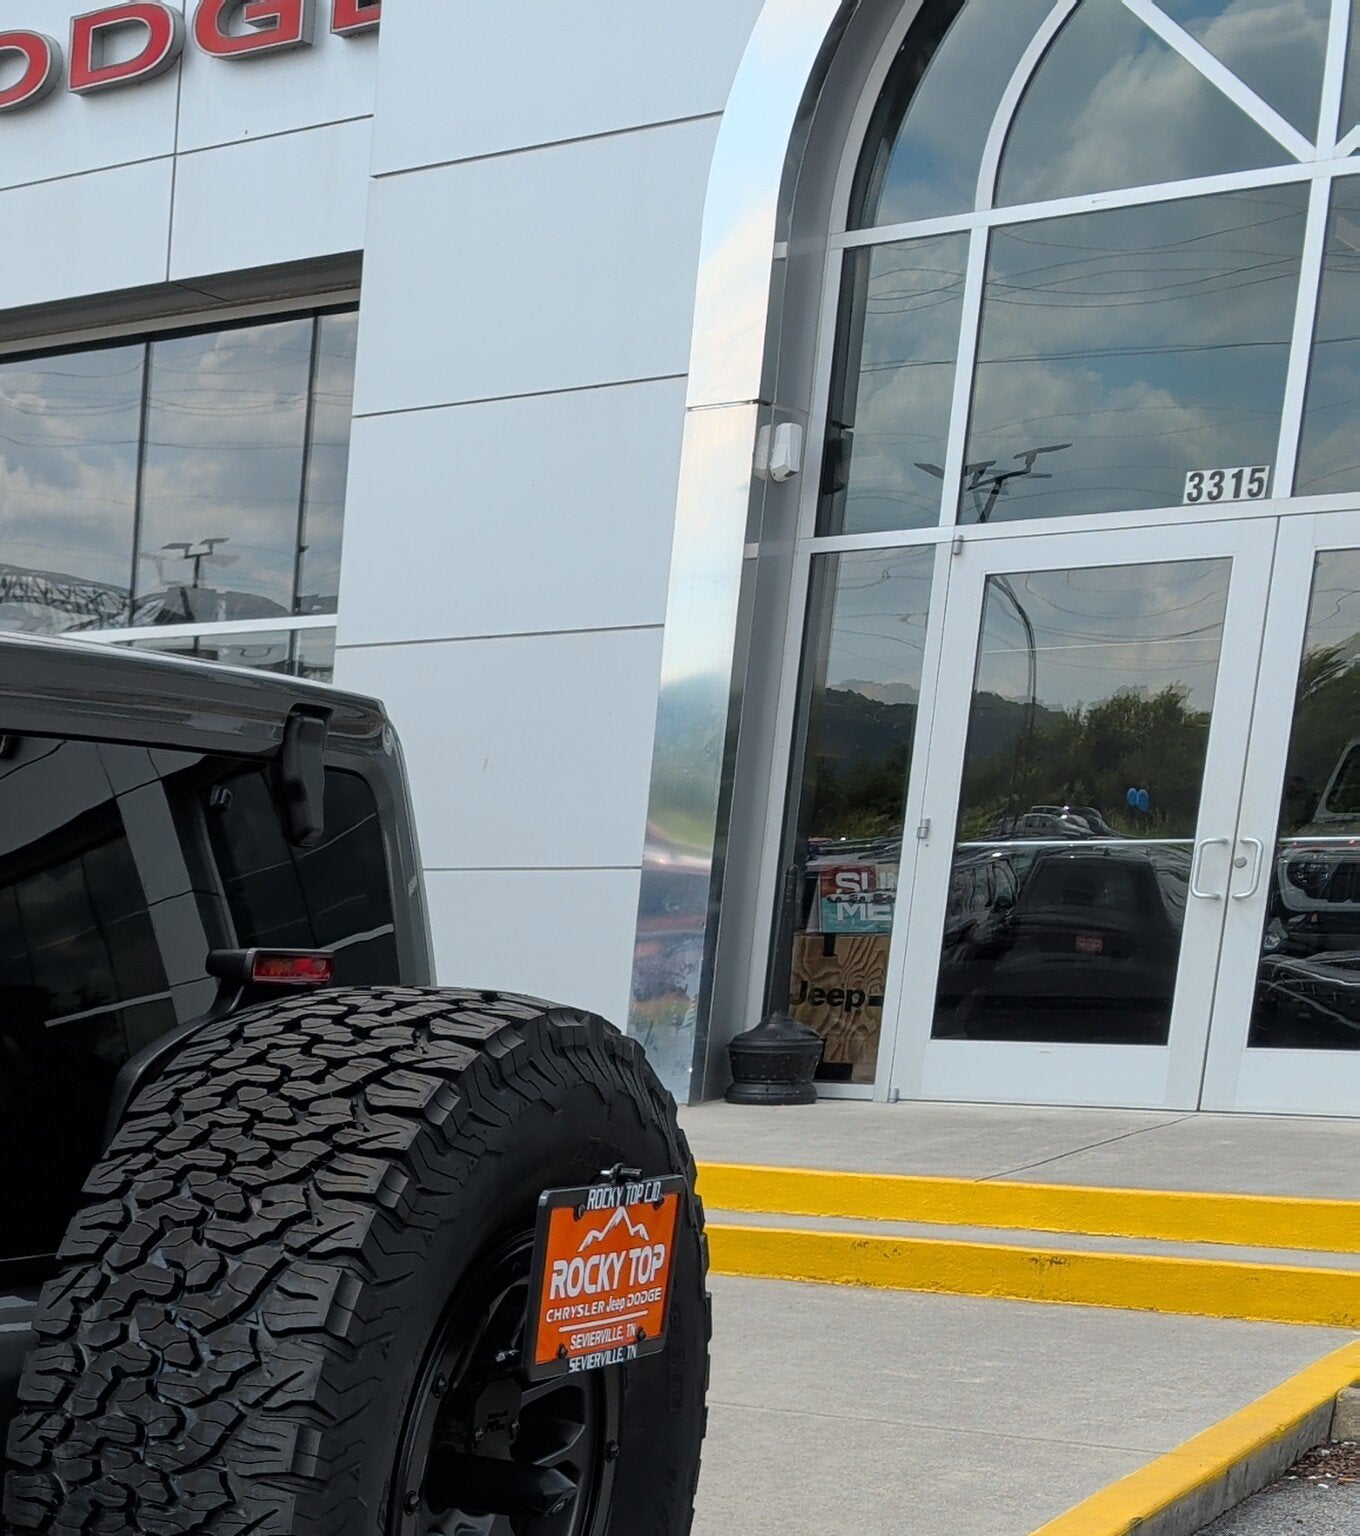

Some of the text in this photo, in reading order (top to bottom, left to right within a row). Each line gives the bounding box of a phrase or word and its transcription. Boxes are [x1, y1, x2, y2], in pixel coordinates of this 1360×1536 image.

[1186, 467, 1267, 502] 3315
[789, 980, 866, 1013] Jeep
[586, 1185, 626, 1210] ROCKY
[626, 1183, 644, 1206] TOP
[549, 1243, 665, 1300] ROCKY TOP
[545, 1287, 663, 1323] CHRYSLER Jeep DODGE
[570, 1322, 636, 1350] SEVIERVILLE, TN
[568, 1344, 638, 1373] SEVIERVILLE, TN
